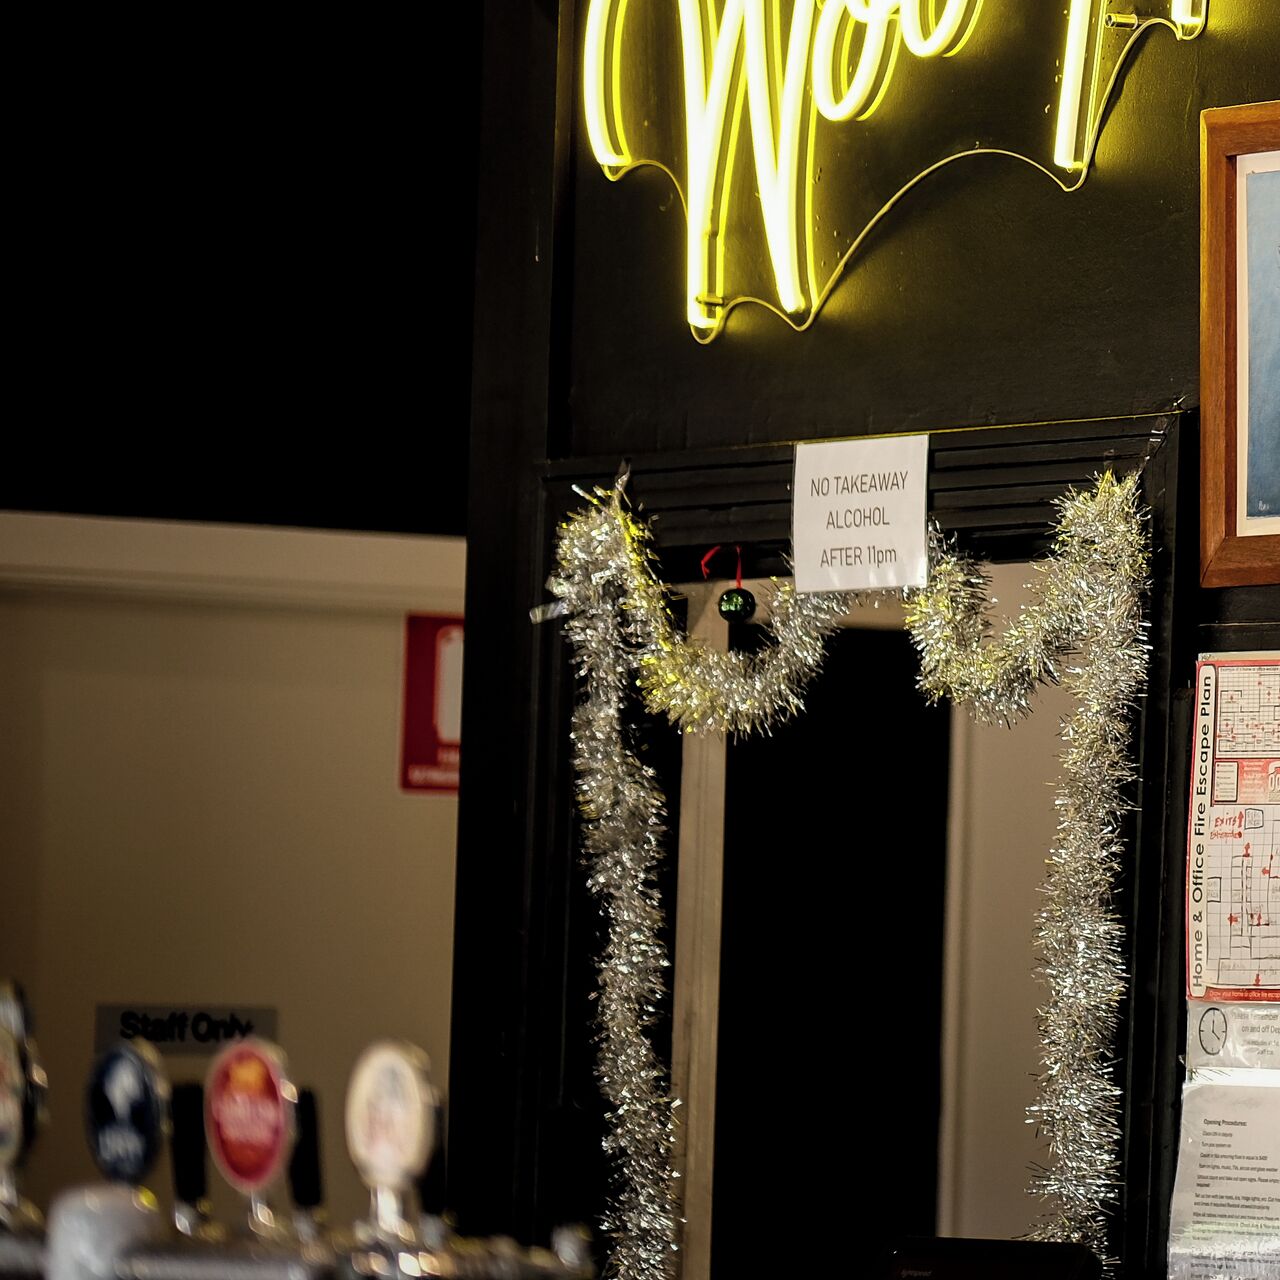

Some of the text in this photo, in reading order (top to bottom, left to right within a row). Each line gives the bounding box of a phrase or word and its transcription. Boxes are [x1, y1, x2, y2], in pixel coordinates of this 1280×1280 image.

[810, 470, 908, 497] NO TAKEAWAY
[826, 506, 890, 530] ALCOHOL
[820, 545, 897, 568] AFTER 11pm
[1192, 676, 1212, 987] Home & Office Fire Escape Plan
[120, 1010, 254, 1042] Staff Only
